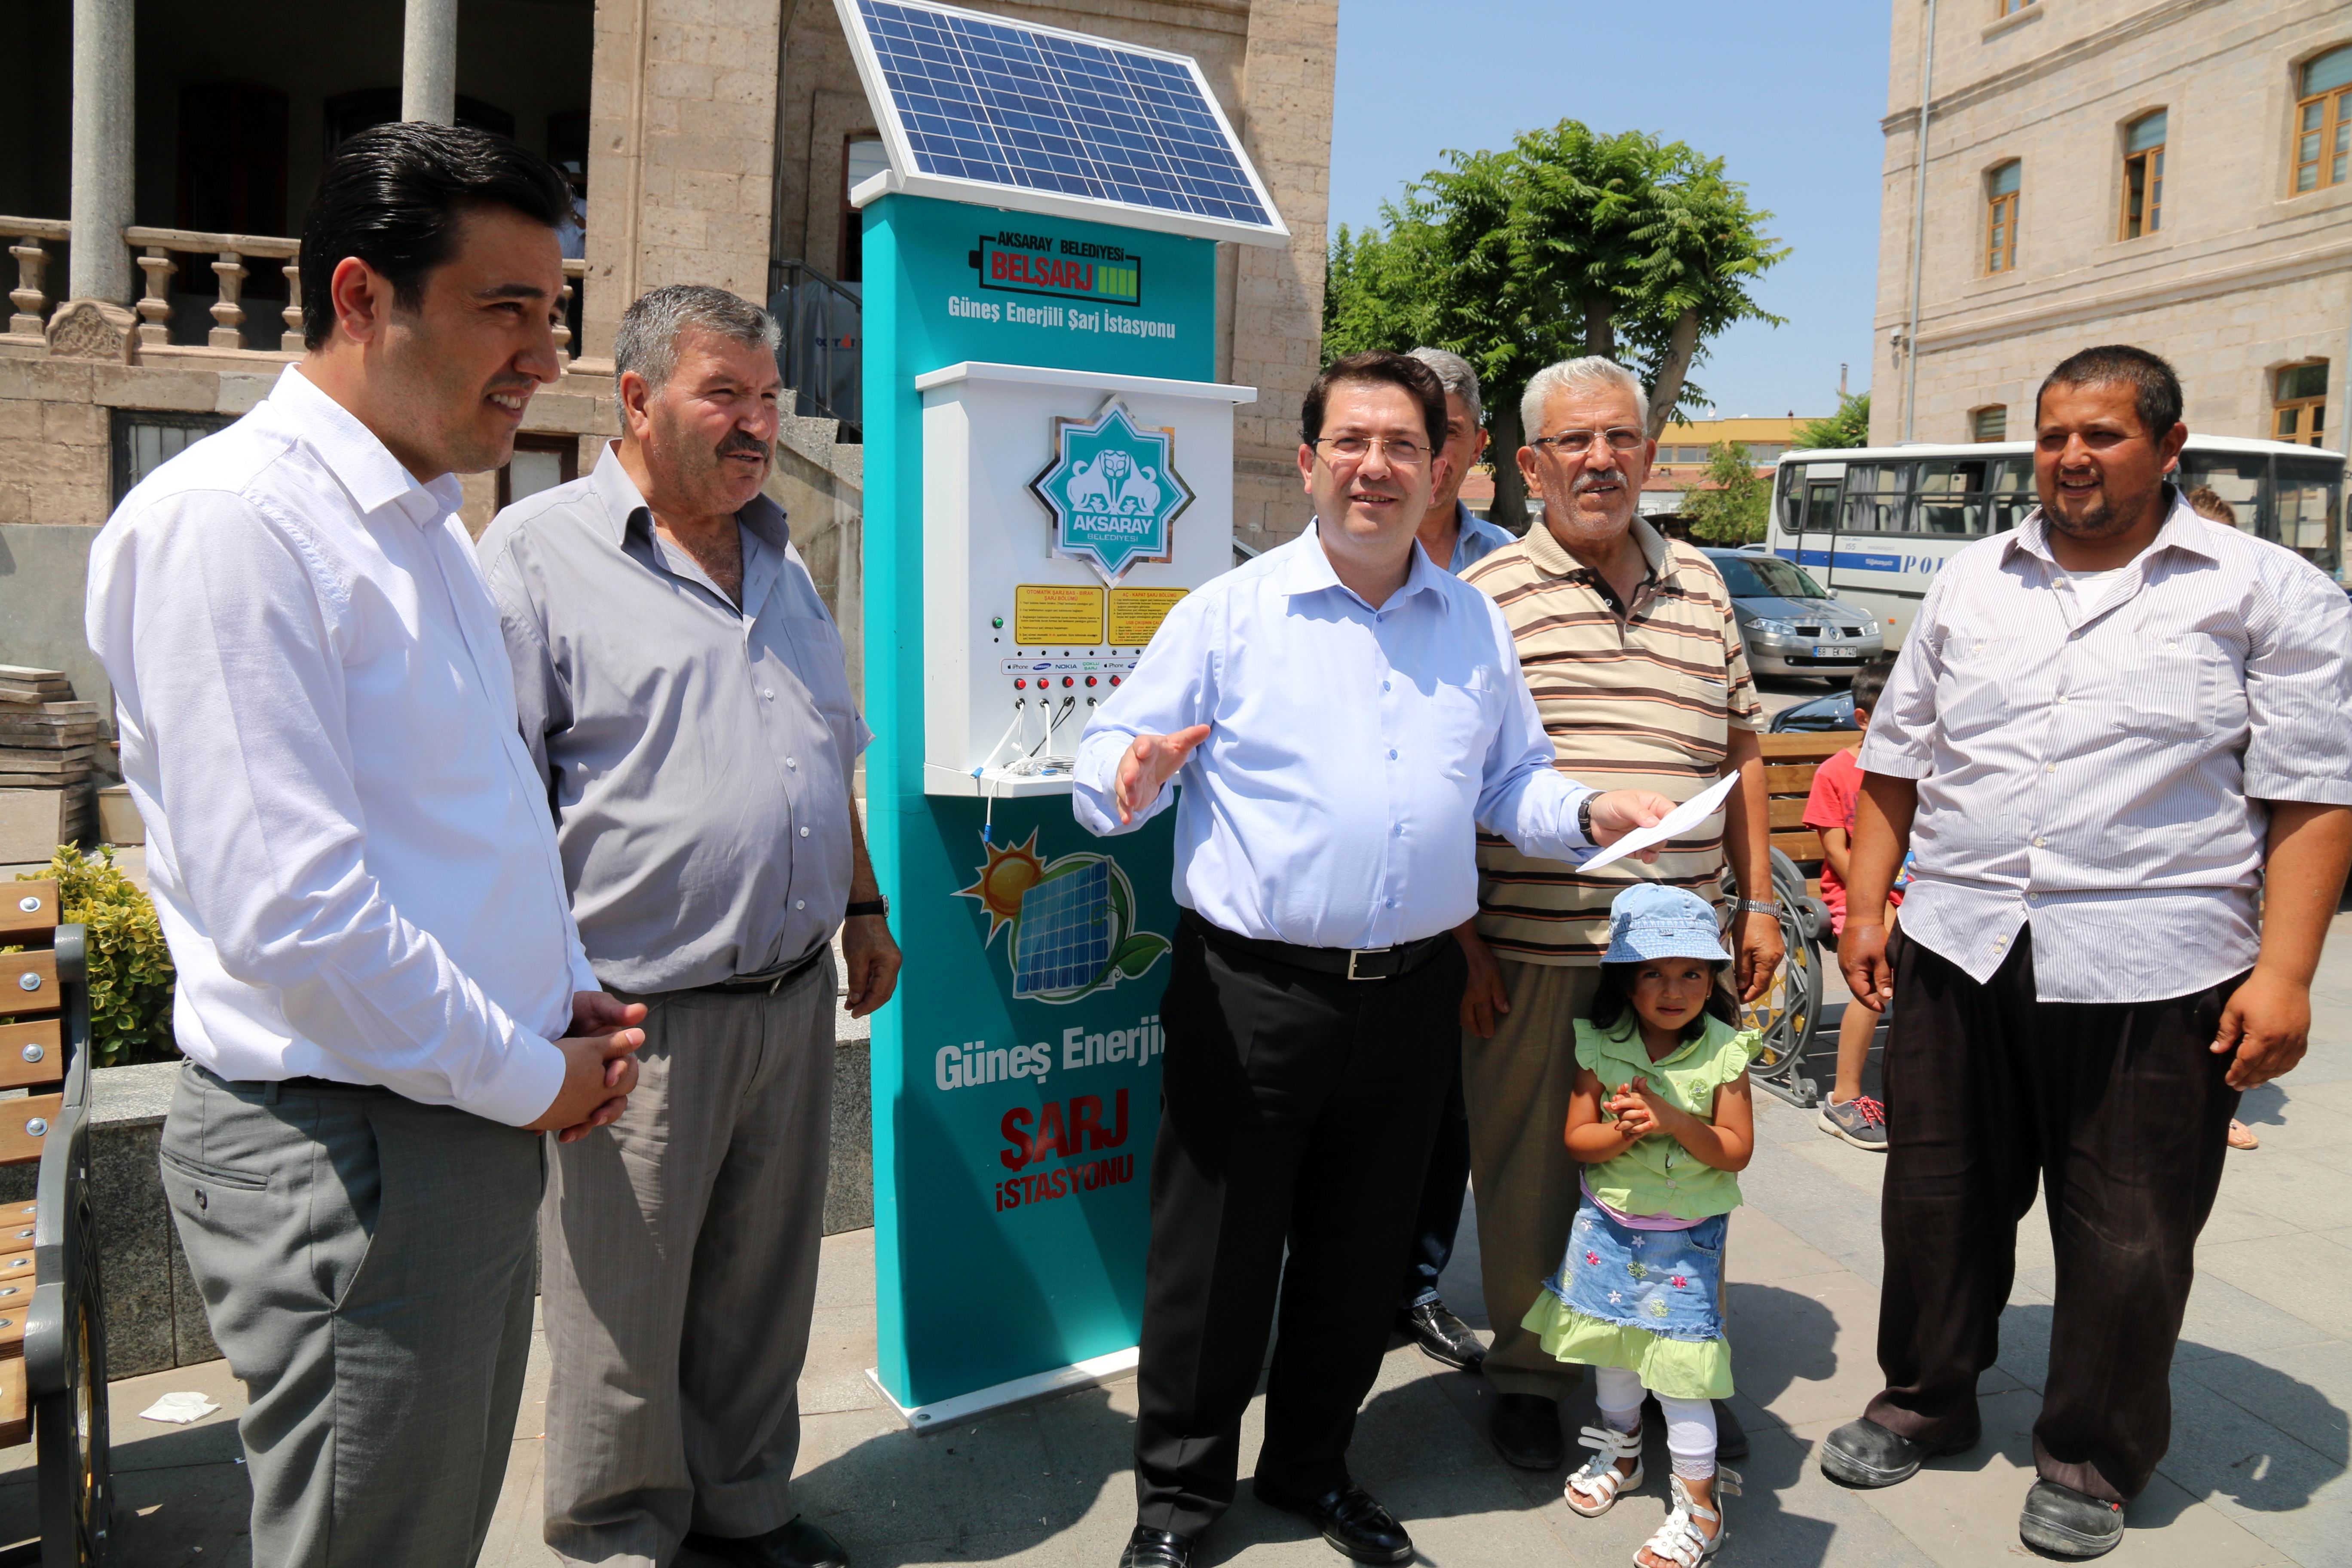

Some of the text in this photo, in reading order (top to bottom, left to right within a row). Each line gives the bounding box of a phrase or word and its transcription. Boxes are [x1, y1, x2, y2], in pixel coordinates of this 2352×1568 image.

[997, 231, 1053, 252] AKSARAY
[992, 251, 1093, 291] BELŞARJ
[948, 296, 1176, 339] Güneş Enerjili Şarj İstasyonu
[1073, 514, 1153, 534] AKSARAY
[935, 1040, 1051, 1090] Güneş
[1000, 1088, 1129, 1173] ŞARJ
